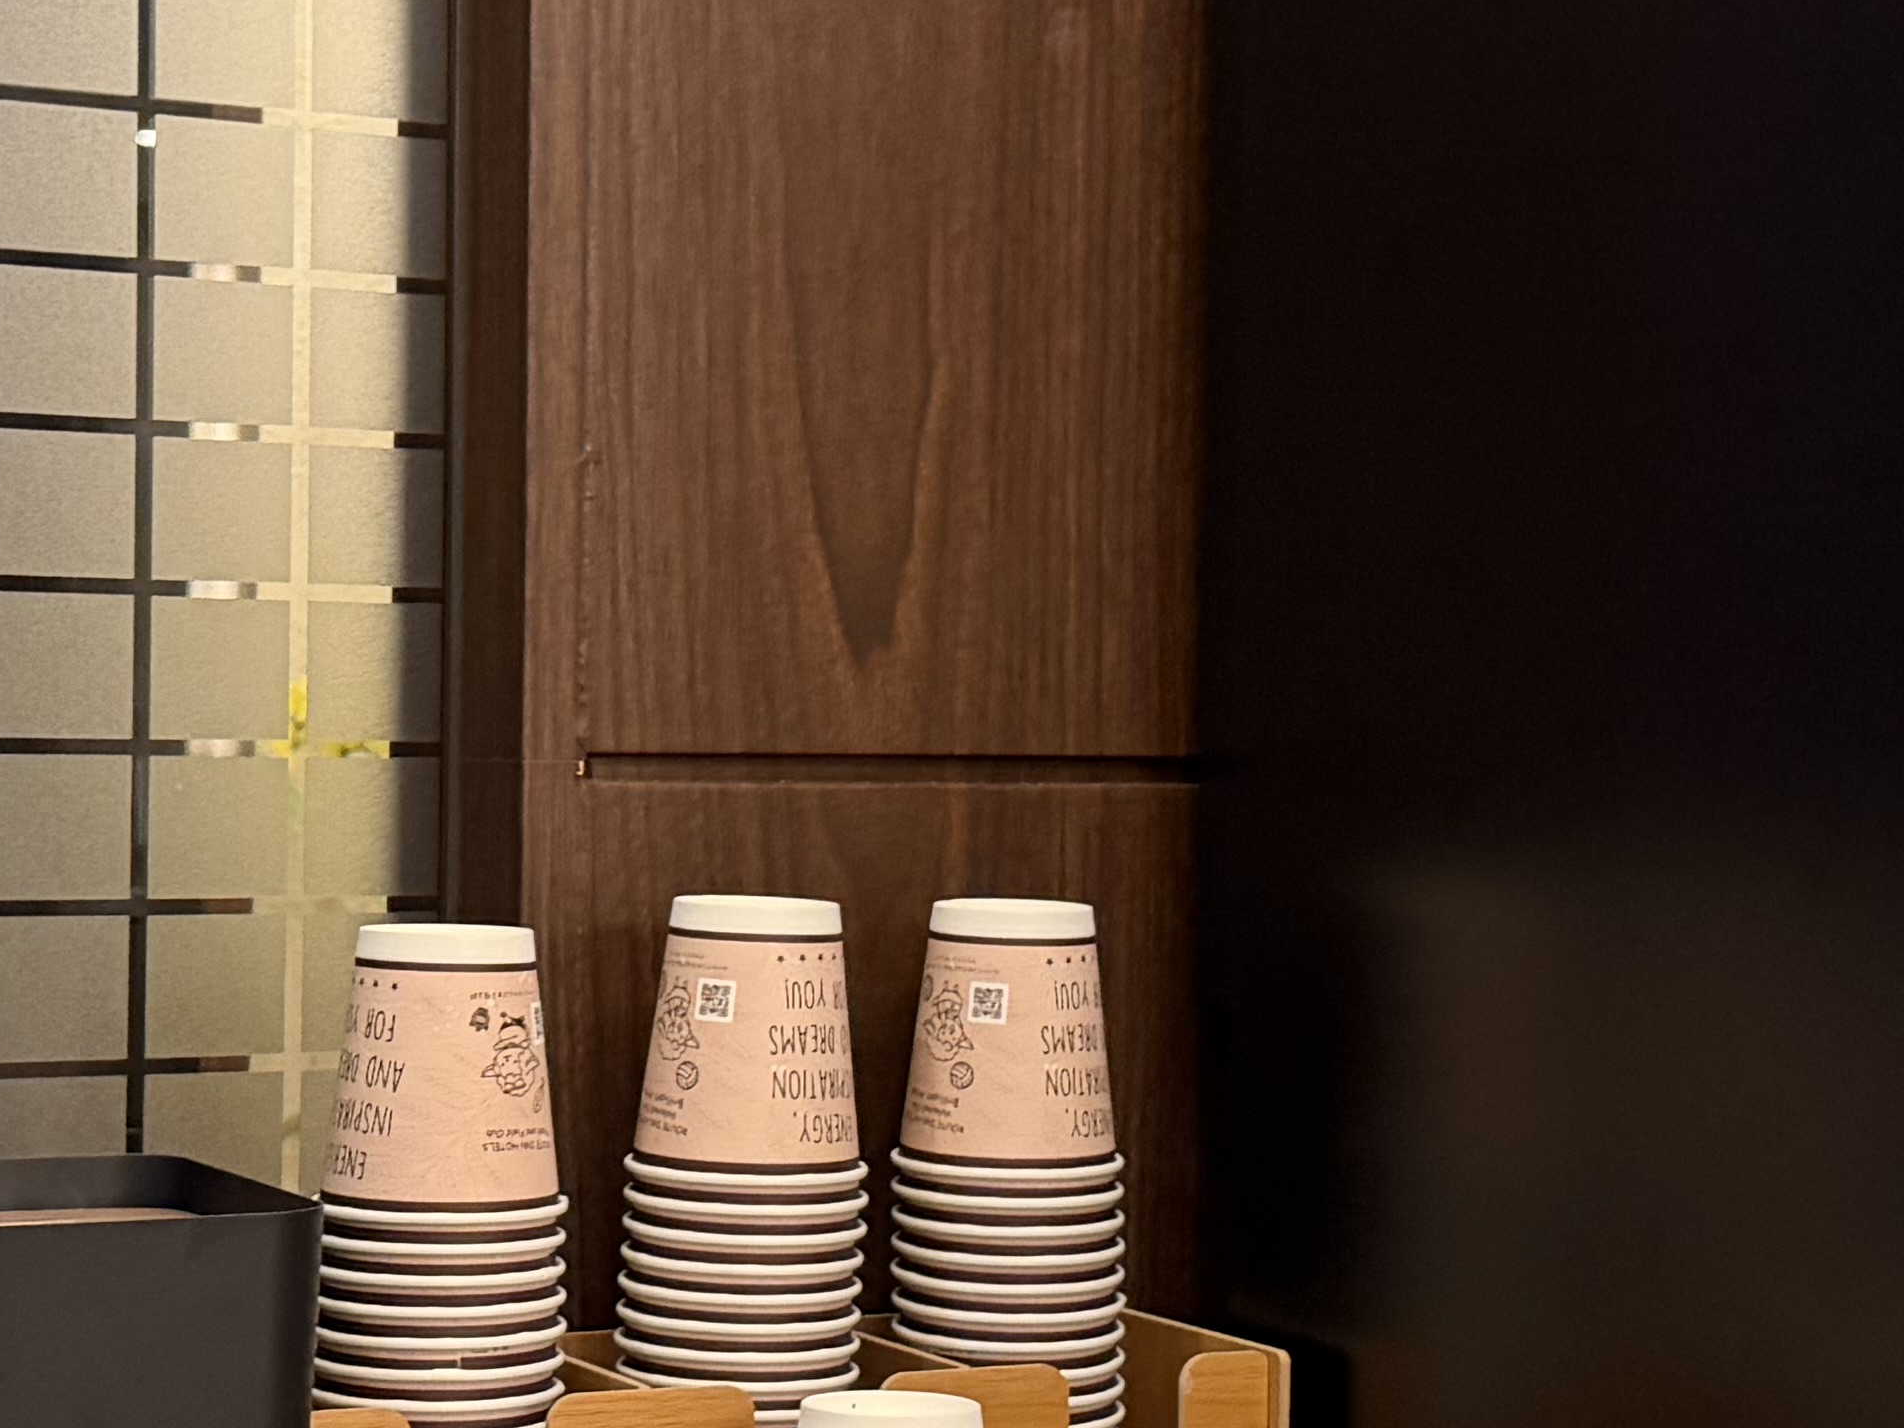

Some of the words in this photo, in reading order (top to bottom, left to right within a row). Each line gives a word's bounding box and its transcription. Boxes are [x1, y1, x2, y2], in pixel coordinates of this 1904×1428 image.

[784, 978, 826, 1010] YOU!
[1054, 980, 1089, 1011] YOU!
[365, 1008, 396, 1043] FOR
[769, 1025, 835, 1055] DREAMS
[365, 1055, 405, 1093] AND
